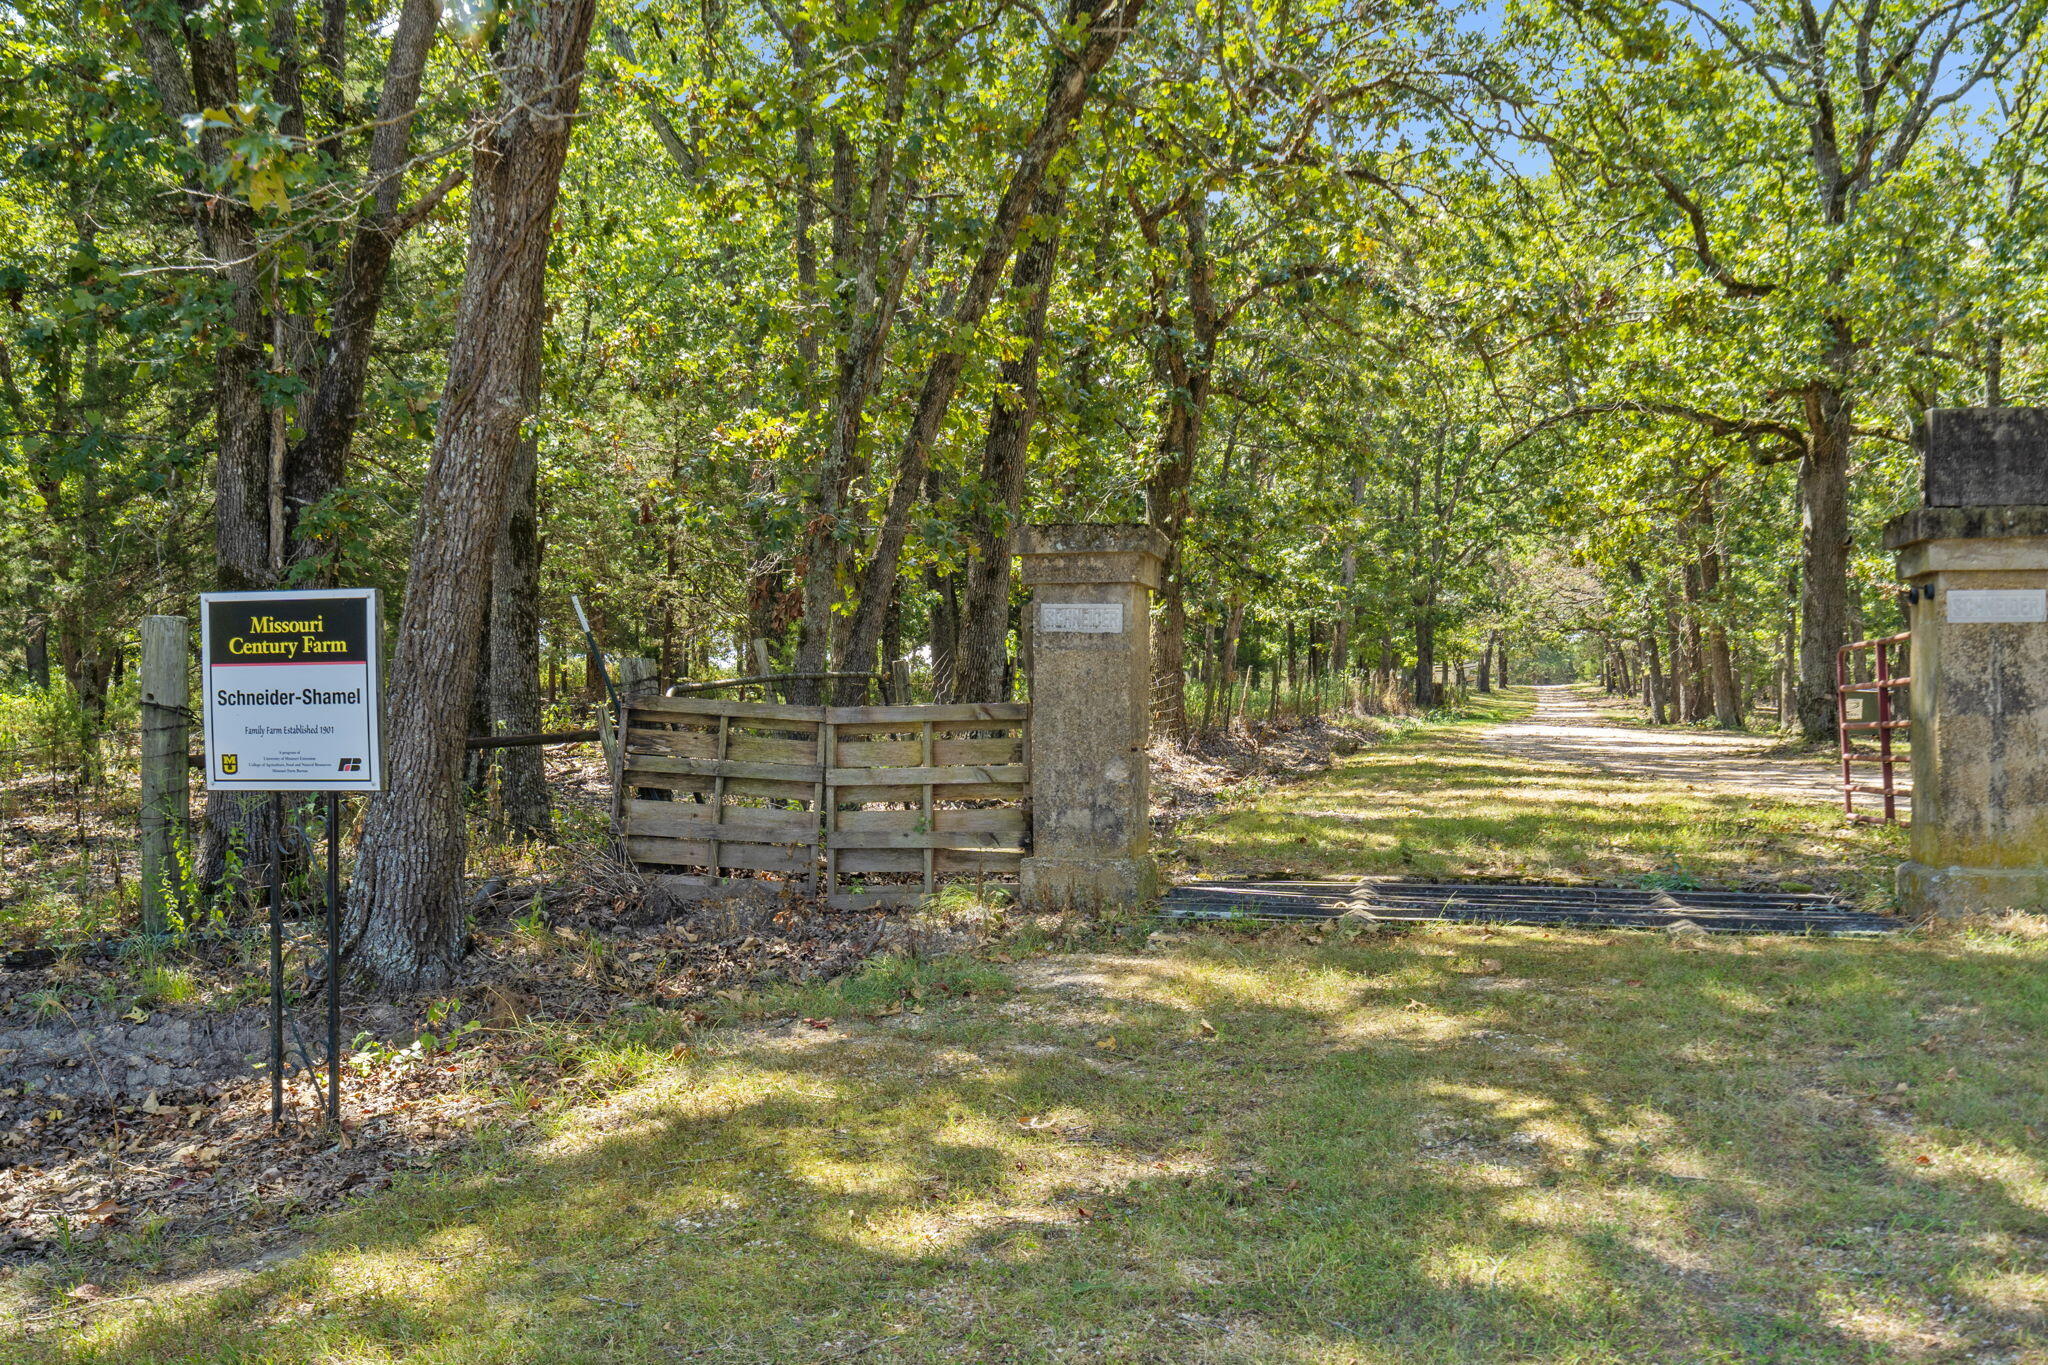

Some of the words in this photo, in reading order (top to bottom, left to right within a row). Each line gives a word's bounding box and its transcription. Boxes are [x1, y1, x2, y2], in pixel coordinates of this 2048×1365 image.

[250, 615, 324, 634] Missouri
[229, 637, 298, 659] Century
[302, 636, 348, 653] Farm
[217, 688, 361, 706] Schneider-Shamel
[245, 725, 265, 738] Family
[266, 726, 282, 735] Farm
[283, 724, 319, 735] Established
[320, 726, 334, 734] 1901
